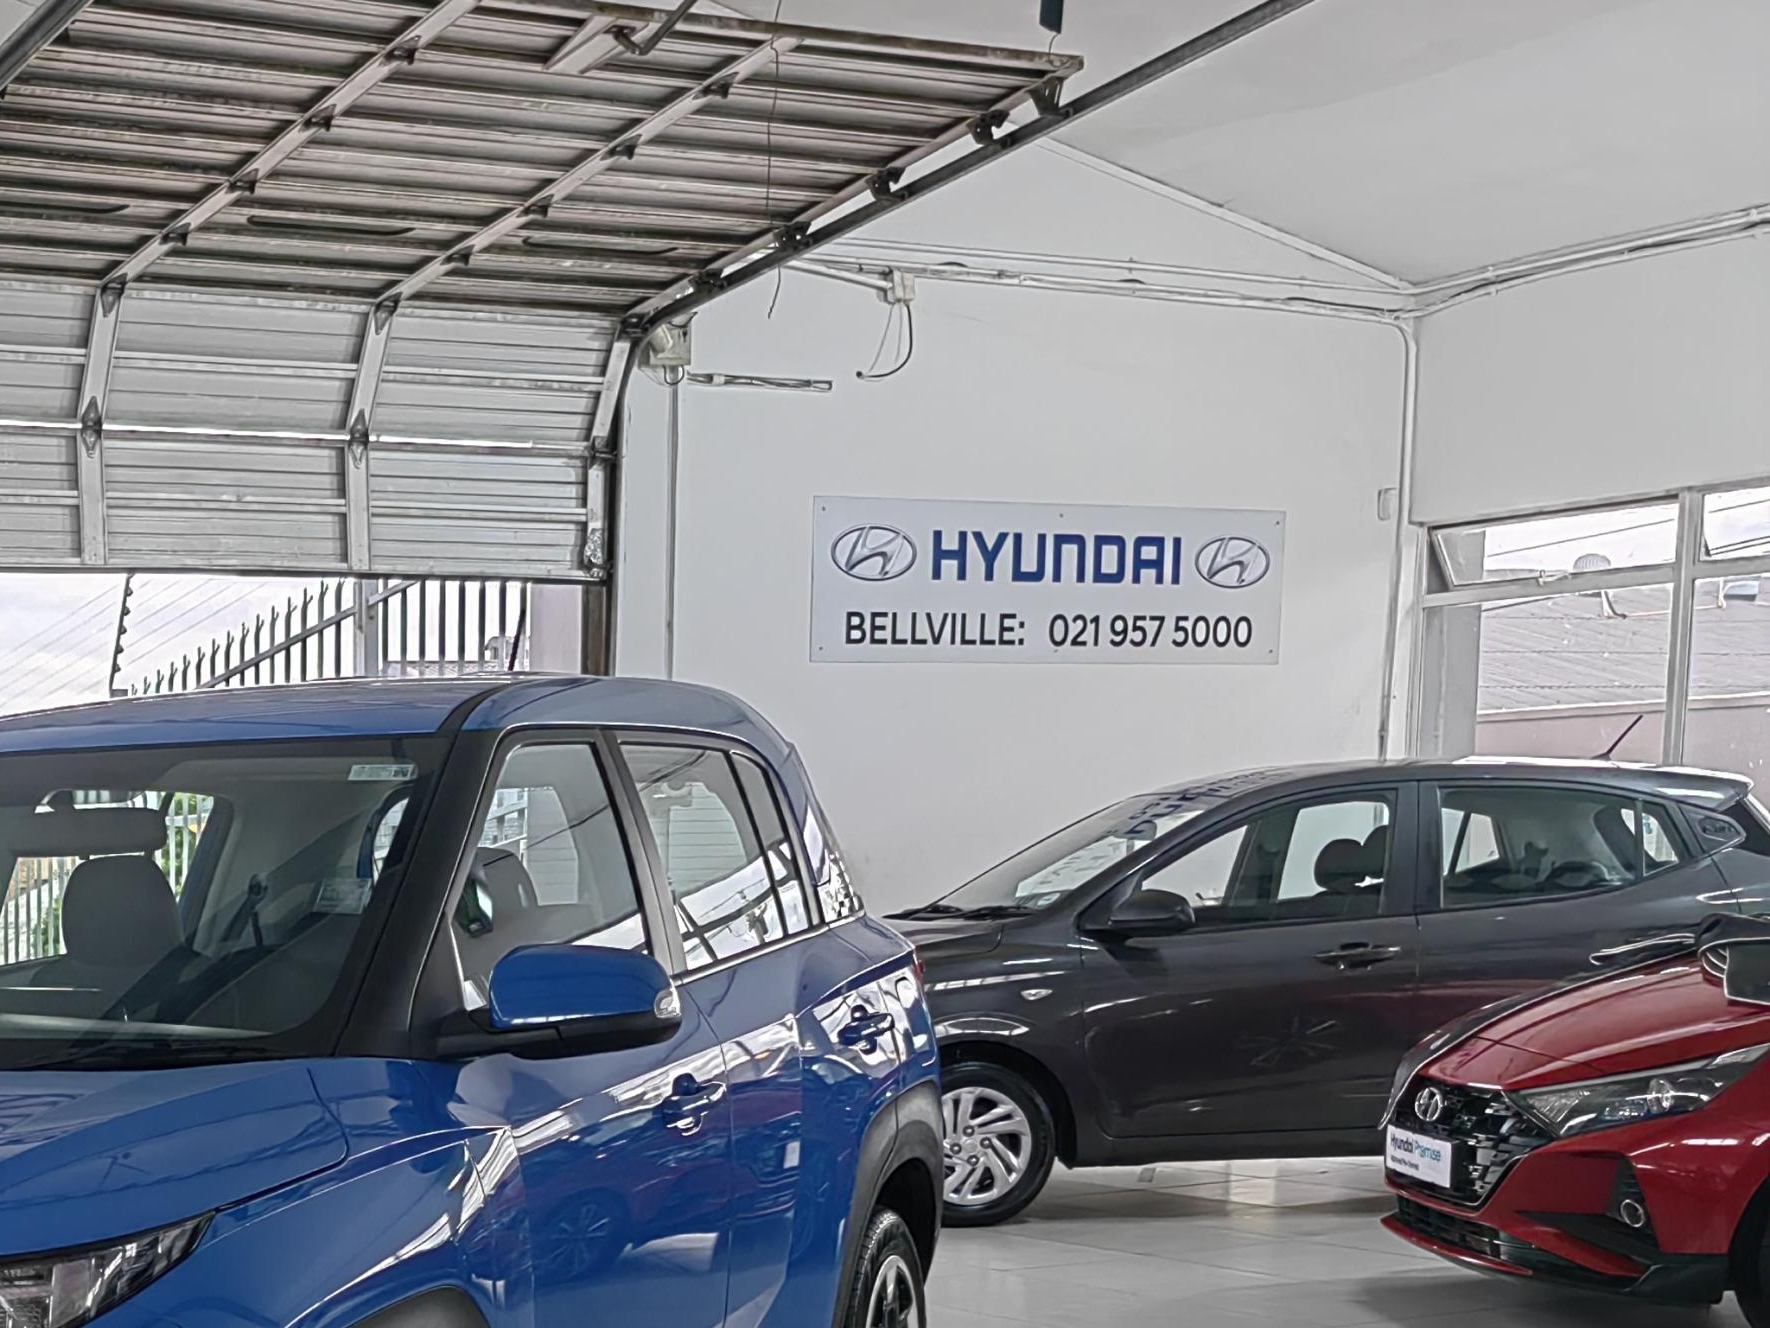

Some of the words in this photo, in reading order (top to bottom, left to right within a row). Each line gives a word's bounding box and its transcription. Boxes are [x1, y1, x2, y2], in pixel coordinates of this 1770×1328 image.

[931, 529, 1182, 585] HYUNDAI
[844, 611, 1026, 645] BELLVILLE:
[1048, 614, 1100, 647] 021
[1109, 615, 1165, 648] 957
[1171, 615, 1253, 648] 5000
